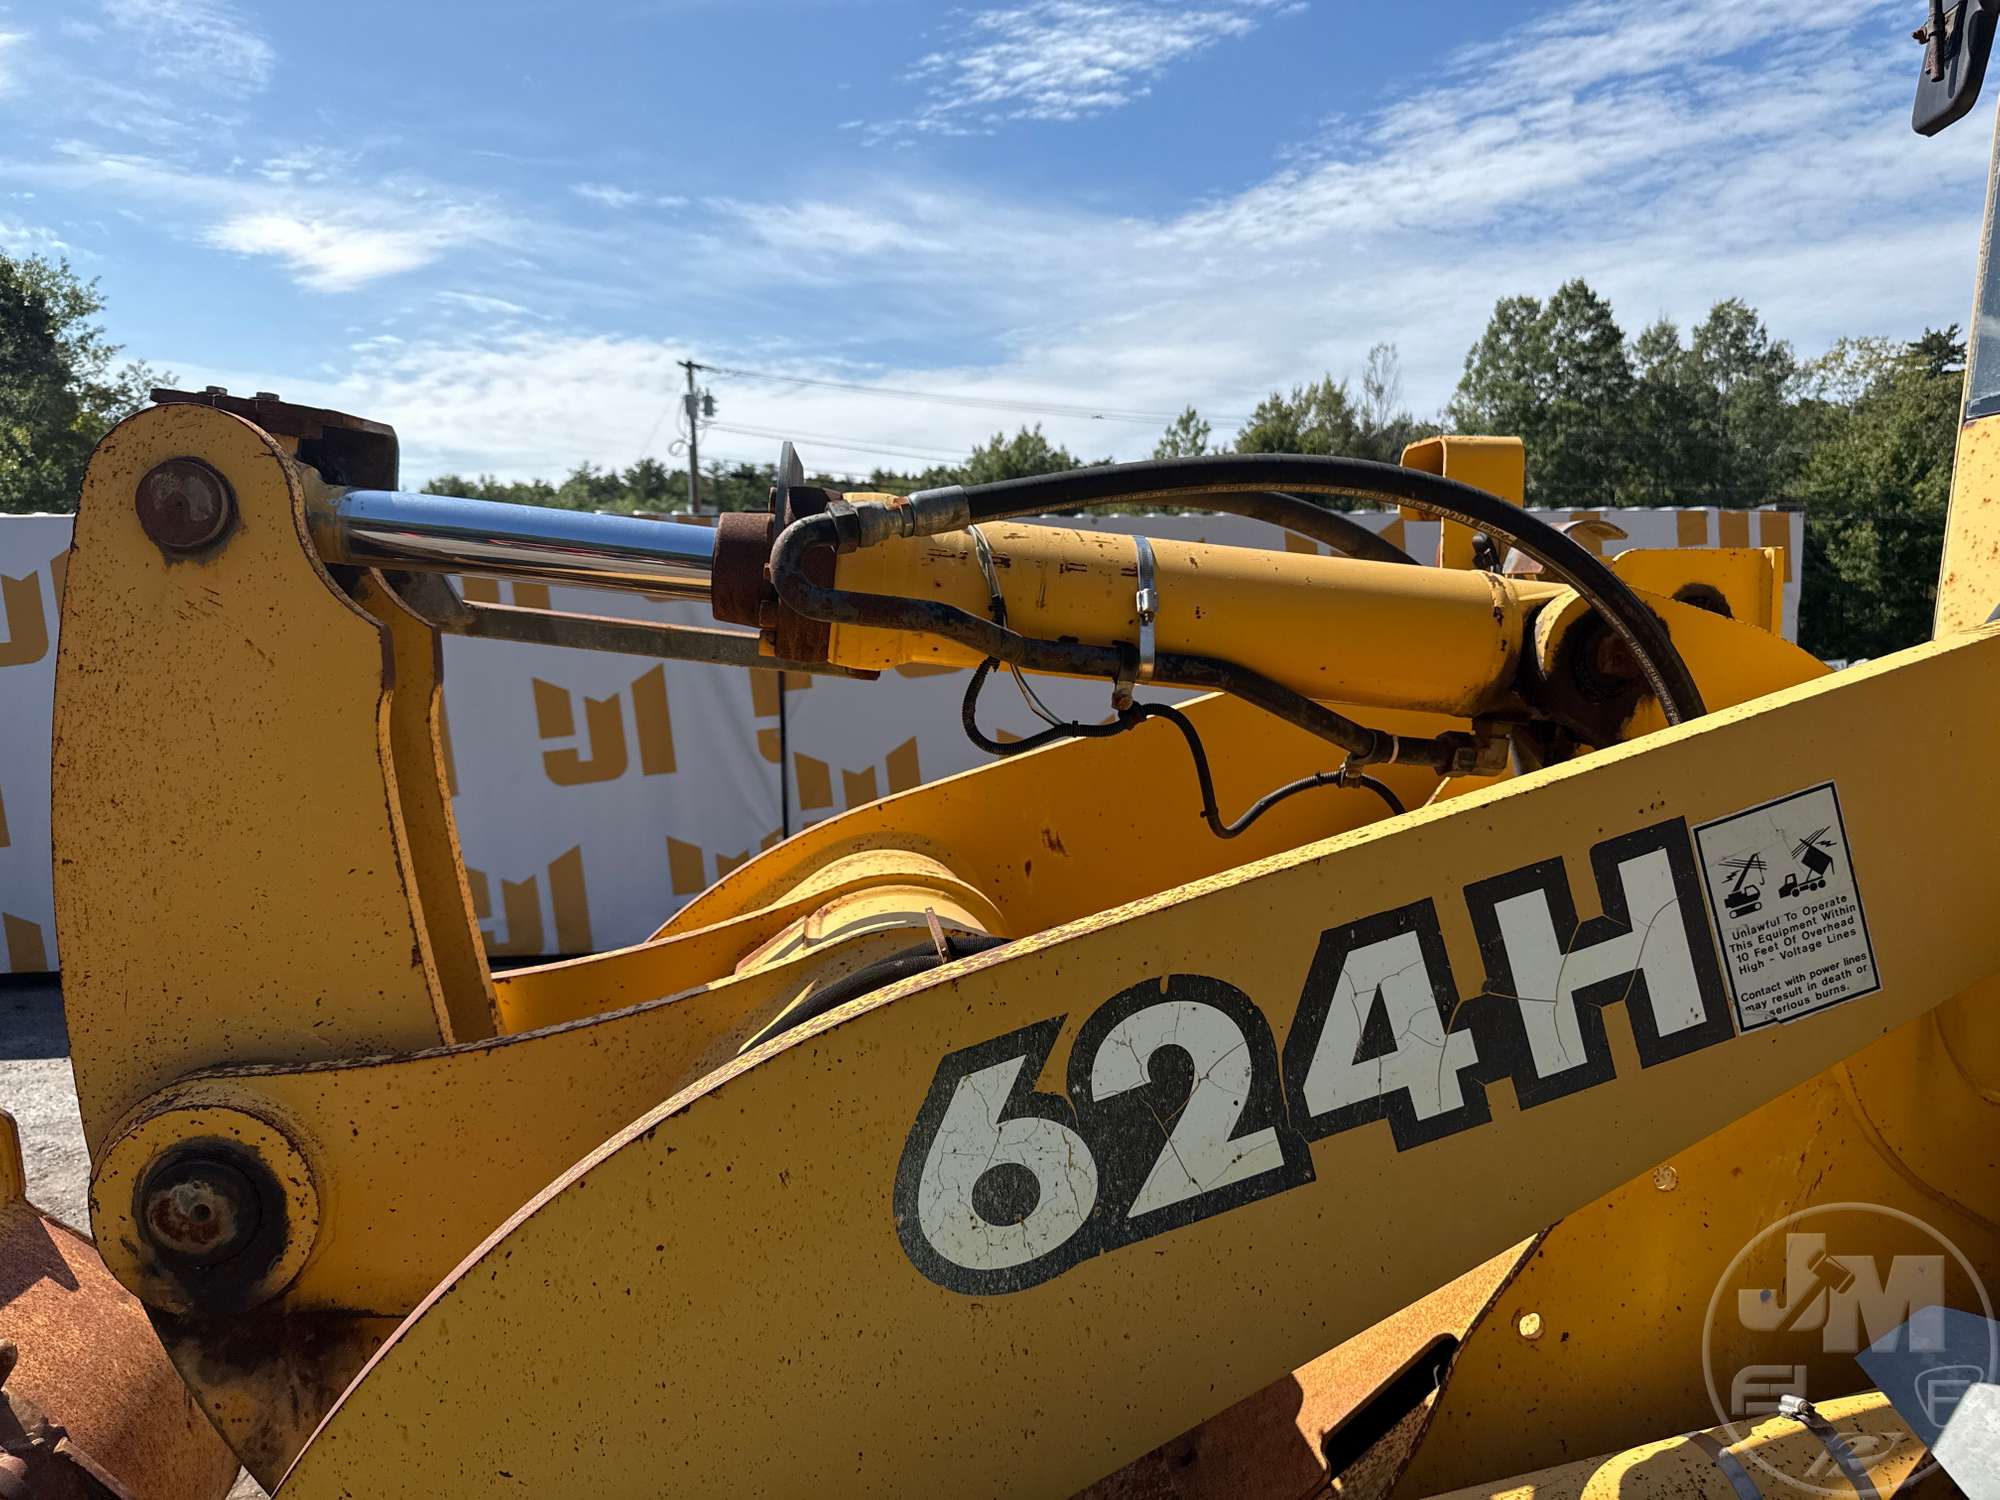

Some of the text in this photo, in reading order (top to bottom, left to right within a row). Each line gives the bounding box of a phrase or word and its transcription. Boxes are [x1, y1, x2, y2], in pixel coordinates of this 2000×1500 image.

[1729, 904, 1856, 952] This Equipment Within
[1732, 896, 1847, 940] Unlawful To Operate
[1736, 916, 1854, 963] 10 Feet Of Overhead
[1739, 960, 1764, 975] High
[1780, 940, 1822, 960] Voltage
[1827, 929, 1856, 944] Lines
[1741, 953, 1866, 1002] Contact with power lines
[1745, 965, 1867, 1012] may result in death or
[1769, 983, 1850, 1016] serious burns.
[908, 832, 1718, 1280] 624H
